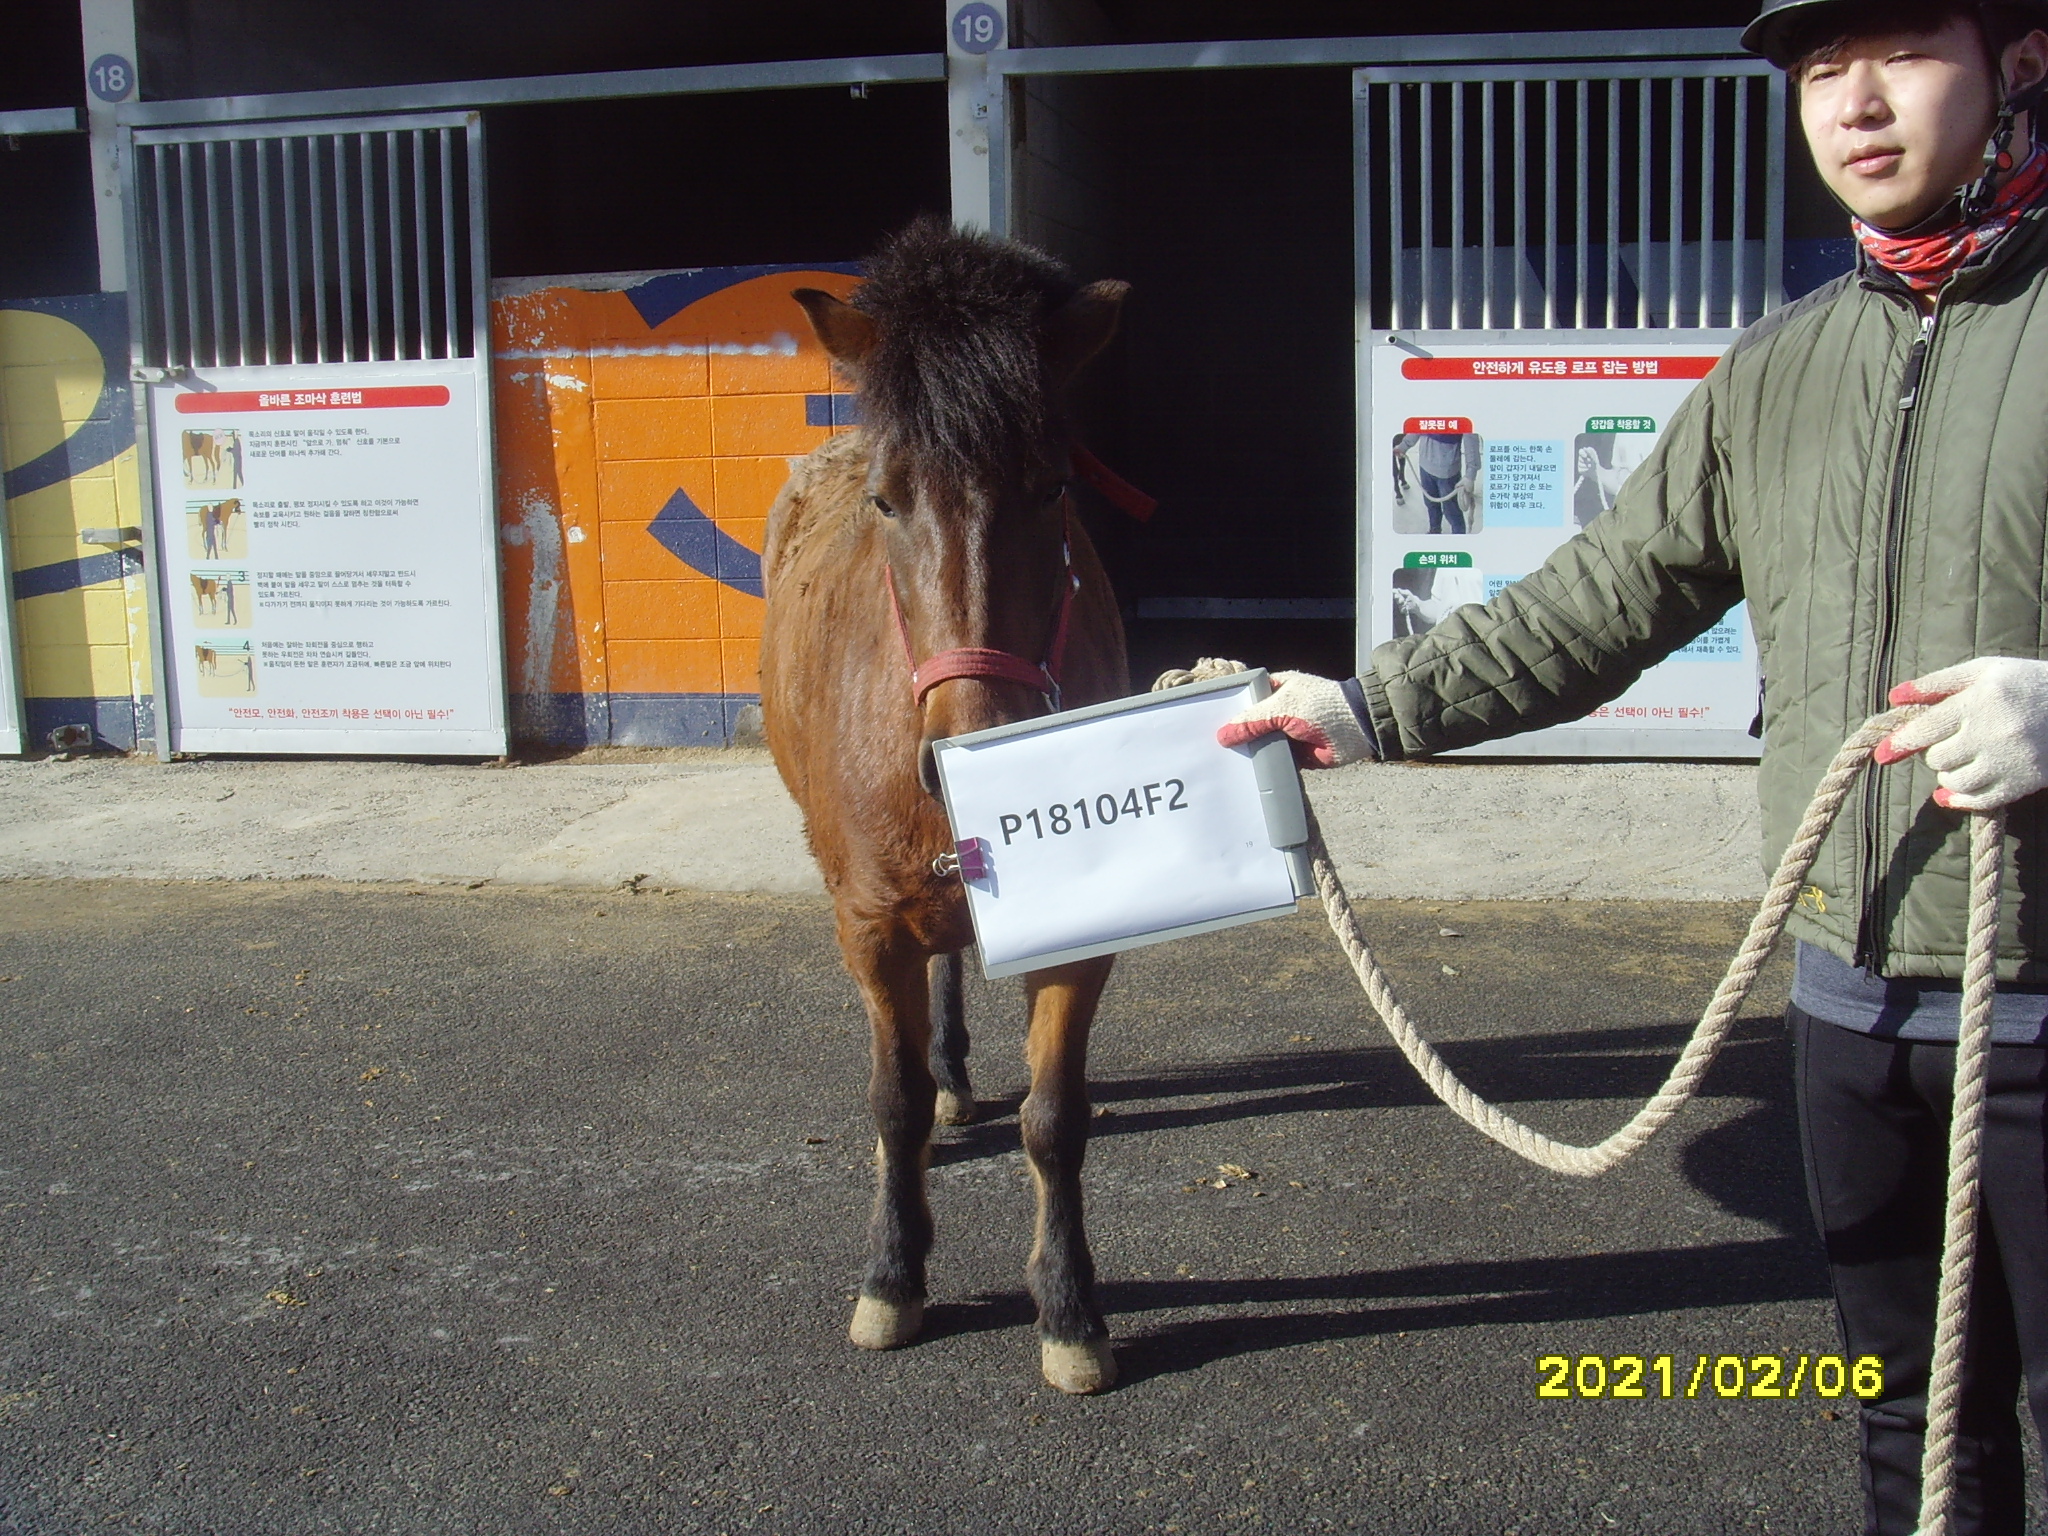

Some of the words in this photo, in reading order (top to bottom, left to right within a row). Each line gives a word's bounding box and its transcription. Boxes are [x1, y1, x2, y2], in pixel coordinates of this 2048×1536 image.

[960, 15, 994, 43] 19
[95, 65, 126, 92] 18
[1473, 361, 1524, 375] 안전하게
[1528, 361, 1568, 375] 유도용
[1571, 361, 1598, 374] 로프
[1602, 360, 1628, 374] 잡는
[1632, 360, 1658, 374] 방법
[259, 393, 291, 407] 올바른
[294, 392, 327, 406] 조마삭
[330, 391, 362, 405] 훈련법
[1419, 420, 1446, 430] 잘못된
[1448, 420, 1458, 430] 예
[1591, 420, 1615, 430] 장갑을
[1617, 420, 1641, 430] 착용할
[1643, 420, 1653, 429] 것
[1419, 554, 1437, 565] 손의
[1440, 554, 1457, 565] 위치
[239, 571, 246, 582] 3
[1489, 580, 1503, 588] 어린
[243, 641, 250, 652] 4
[267, 708, 298, 719] 안전화,
[302, 709, 339, 719] 안전조끼
[342, 708, 370, 719] 착용은
[373, 709, 401, 719] 선택이
[405, 709, 423, 720] 아닌
[1614, 707, 1647, 718] 선택이
[1651, 707, 1673, 718] 아닌
[999, 778, 1188, 846] P18104F2
